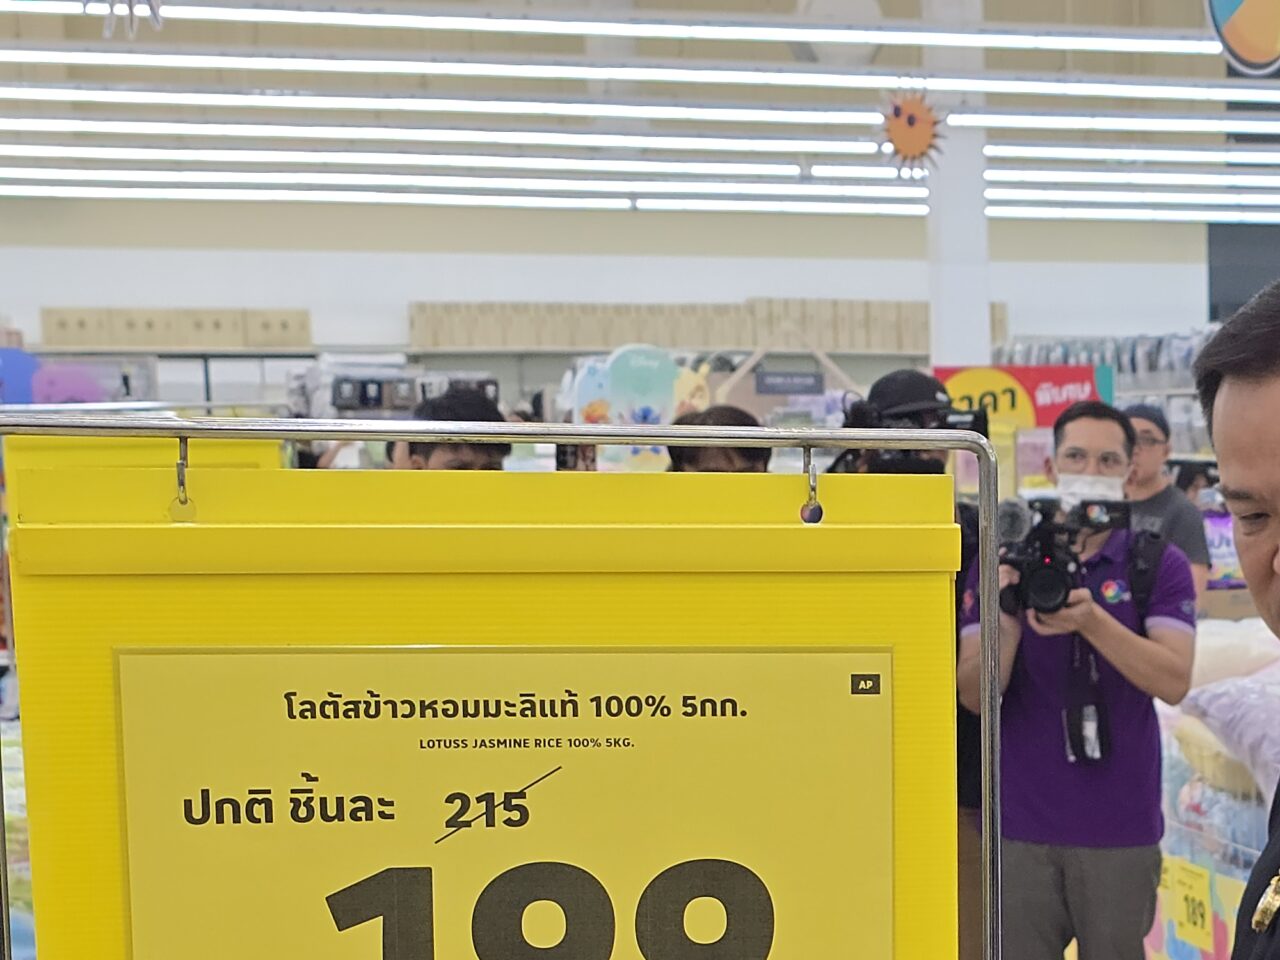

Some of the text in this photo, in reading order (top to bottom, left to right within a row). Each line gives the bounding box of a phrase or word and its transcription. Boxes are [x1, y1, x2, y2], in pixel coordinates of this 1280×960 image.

[950, 387, 1017, 413] าคา
[858, 679, 874, 690] AP
[284, 689, 748, 720] โลตัสข้าวหอมมะลิแท้ 100% 5กก.
[419, 738, 635, 750] LOTUSS JASMINE RICE 100% 5KG.
[183, 771, 531, 829] ปกติ ชิ้นละ 215
